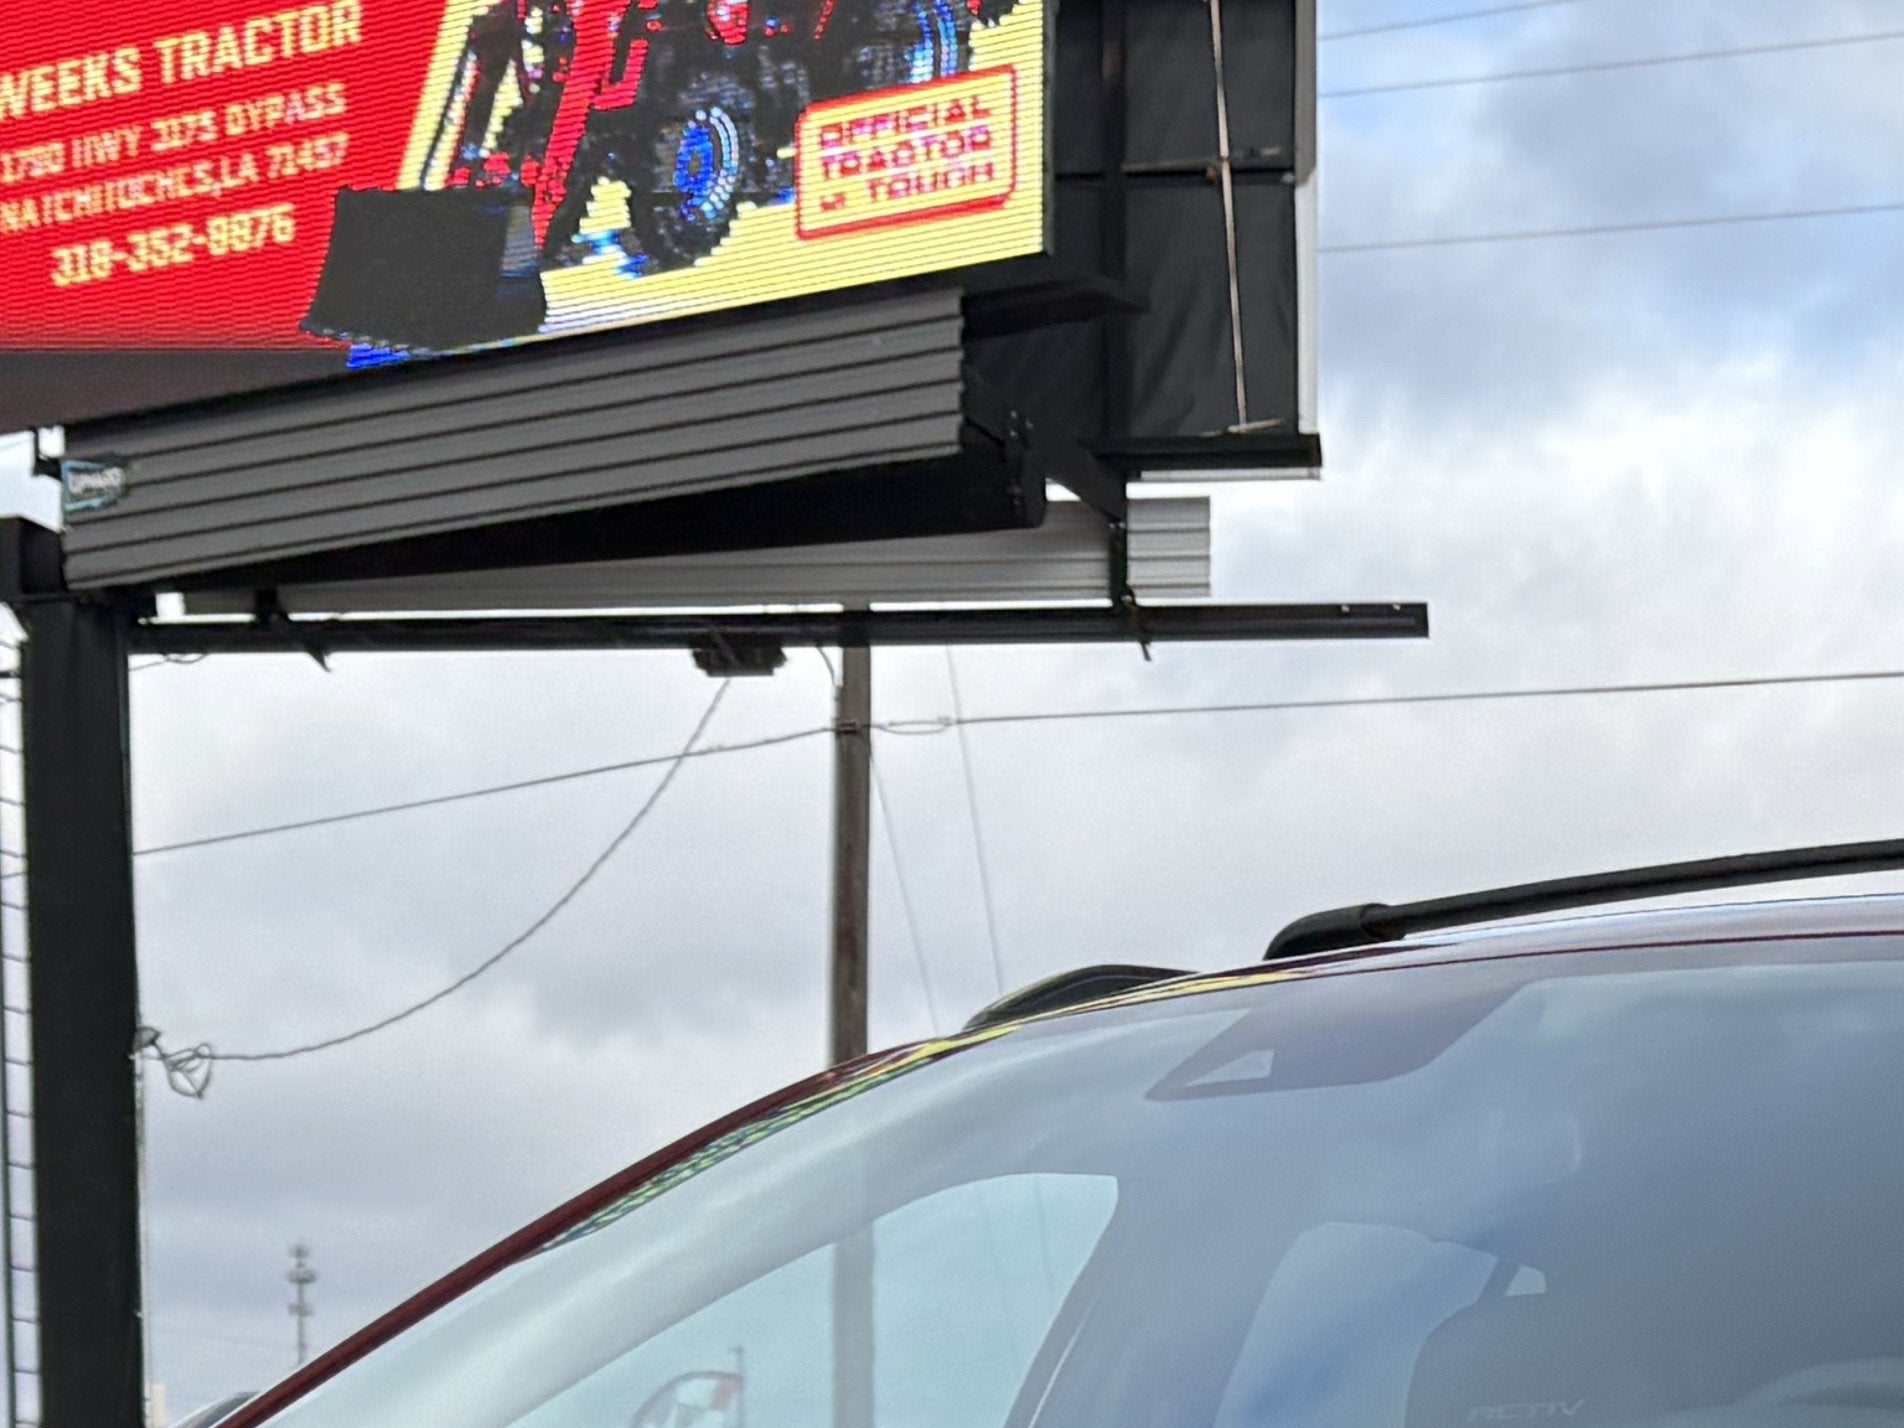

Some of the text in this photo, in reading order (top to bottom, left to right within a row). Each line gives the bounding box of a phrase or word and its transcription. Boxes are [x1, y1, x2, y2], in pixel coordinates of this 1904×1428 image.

[155, 0, 362, 84] TRACTOR
[819, 94, 992, 150] OFFICIAL
[820, 123, 992, 180] TRACTOR
[865, 161, 994, 202] TOUGH
